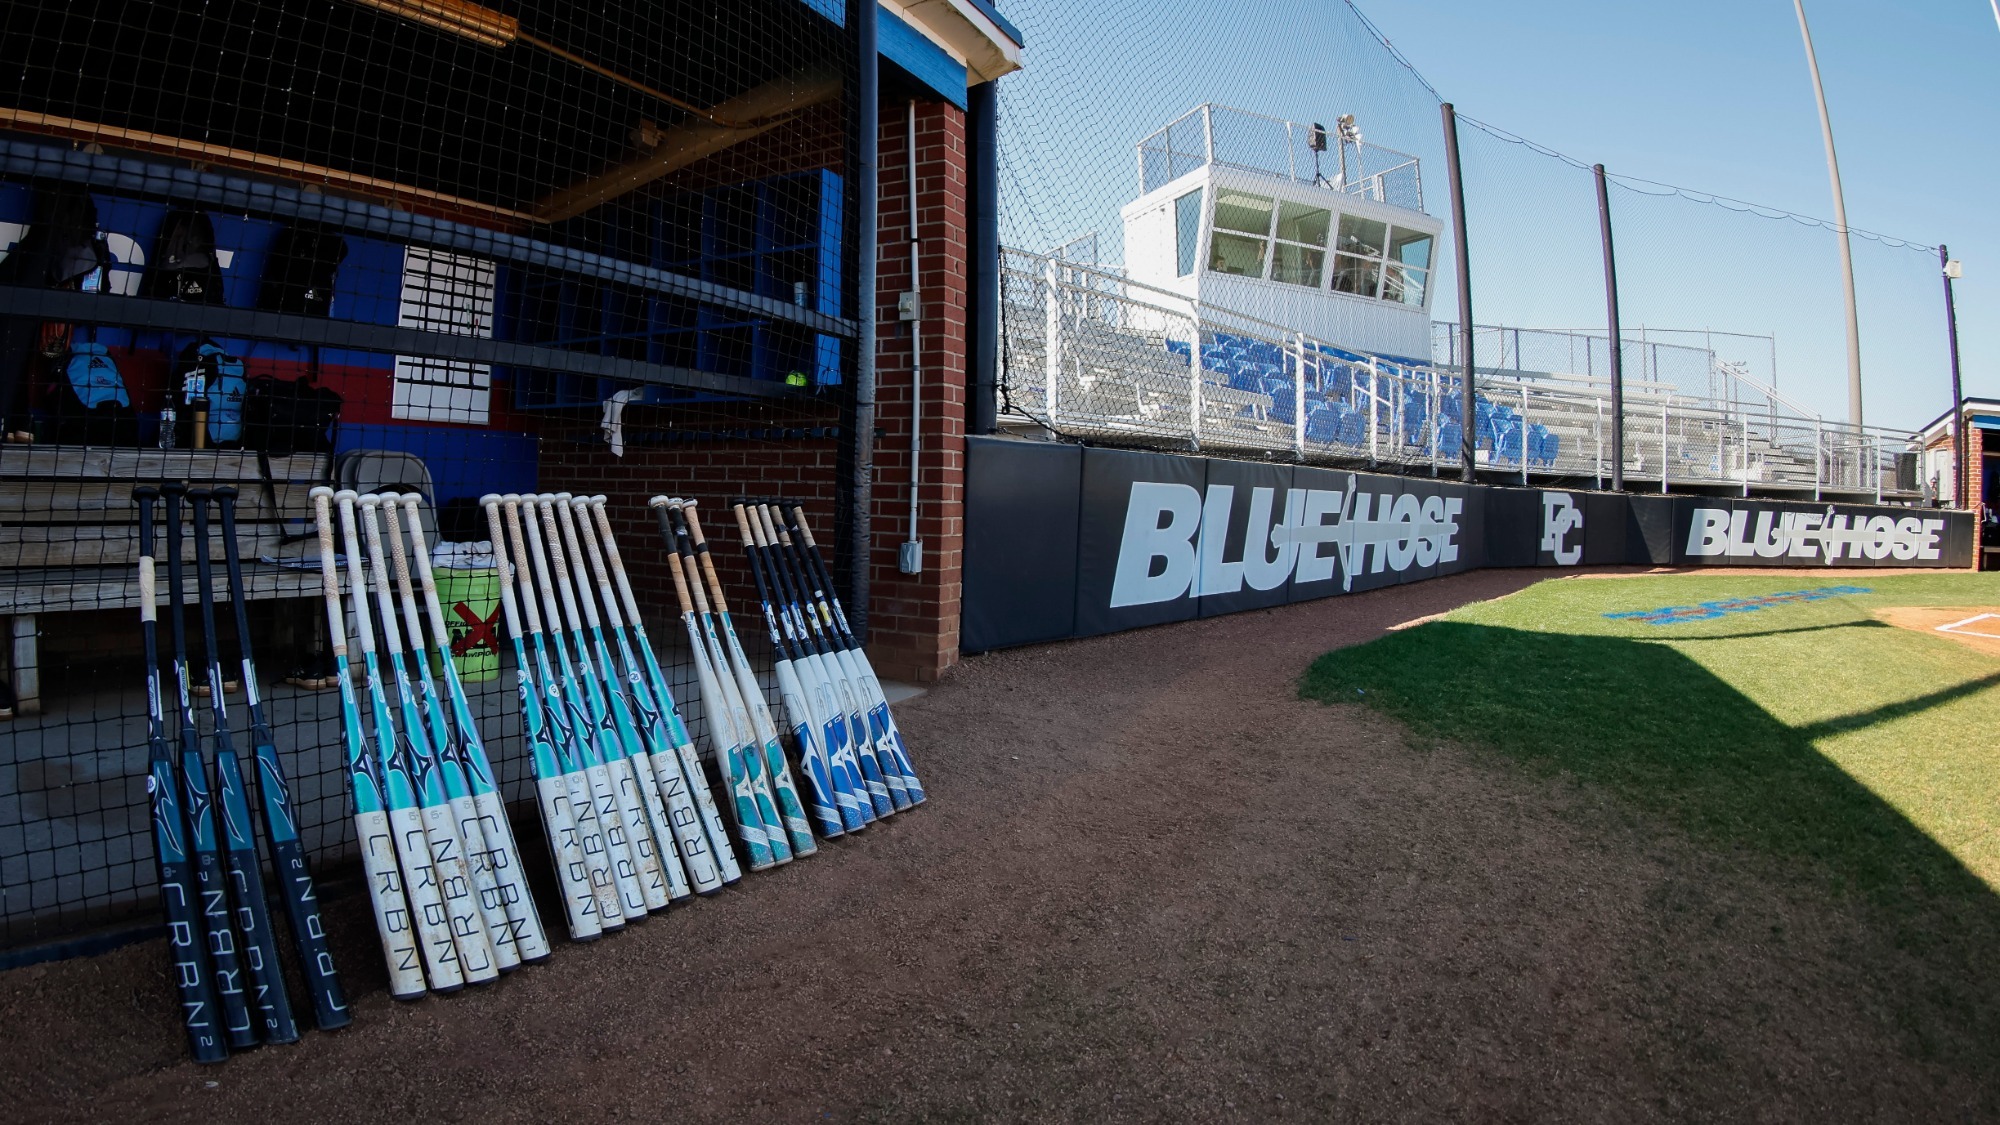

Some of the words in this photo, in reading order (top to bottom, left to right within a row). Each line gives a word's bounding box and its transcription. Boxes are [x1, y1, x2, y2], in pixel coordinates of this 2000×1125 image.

[1110, 481, 1344, 608] BLUE
[1347, 492, 1463, 576] HOSE
[1541, 492, 1583, 566] PC
[1685, 508, 1825, 558] BLUE
[1831, 514, 1944, 560] HOSE
